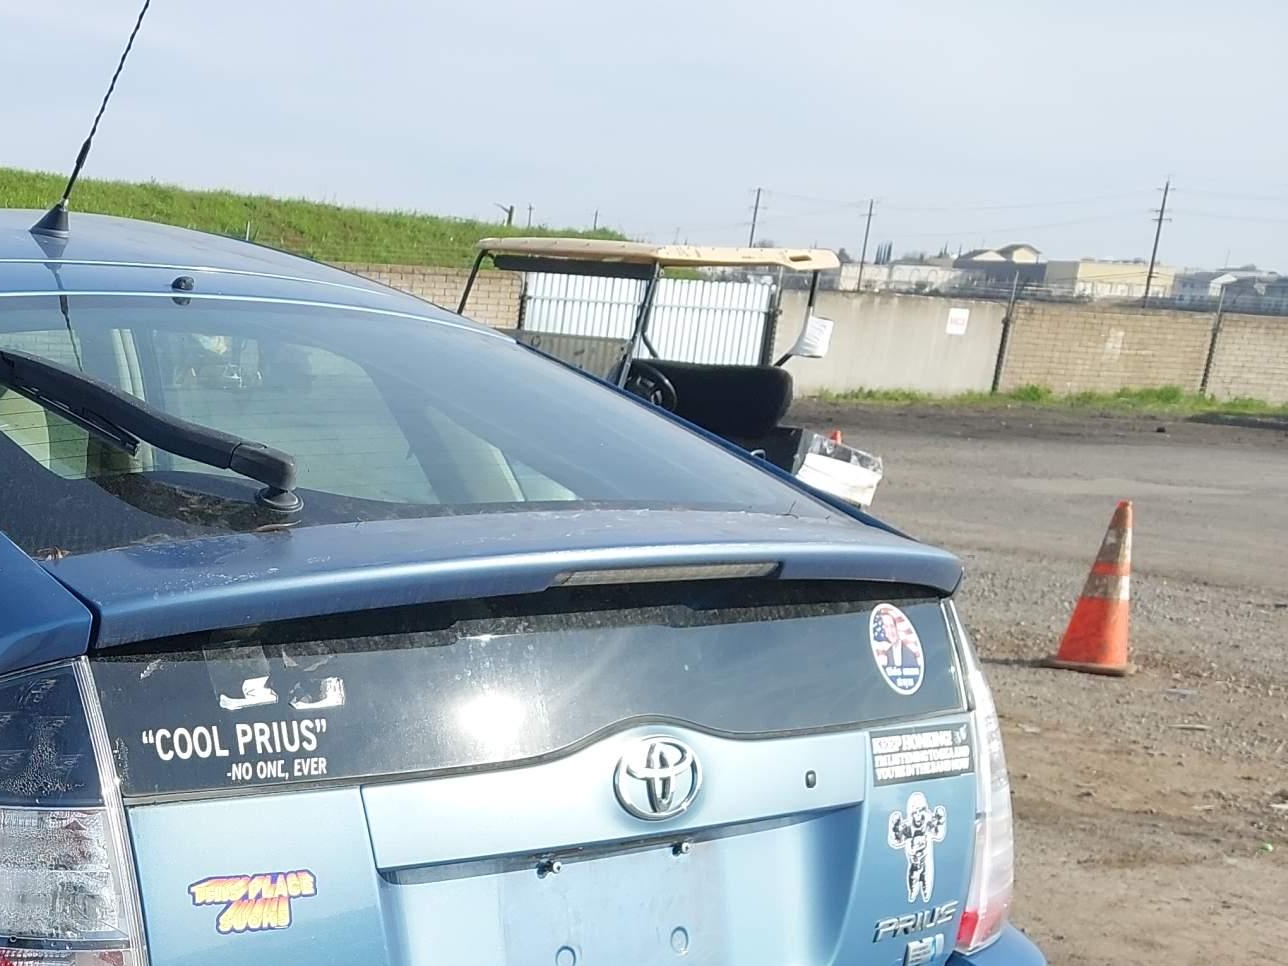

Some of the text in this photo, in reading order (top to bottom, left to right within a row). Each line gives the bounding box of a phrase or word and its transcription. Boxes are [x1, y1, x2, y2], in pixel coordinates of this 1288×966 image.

[293, 757, 327, 776] EVER
[248, 871, 316, 900] PLACE
[872, 900, 959, 943] PRIUS
